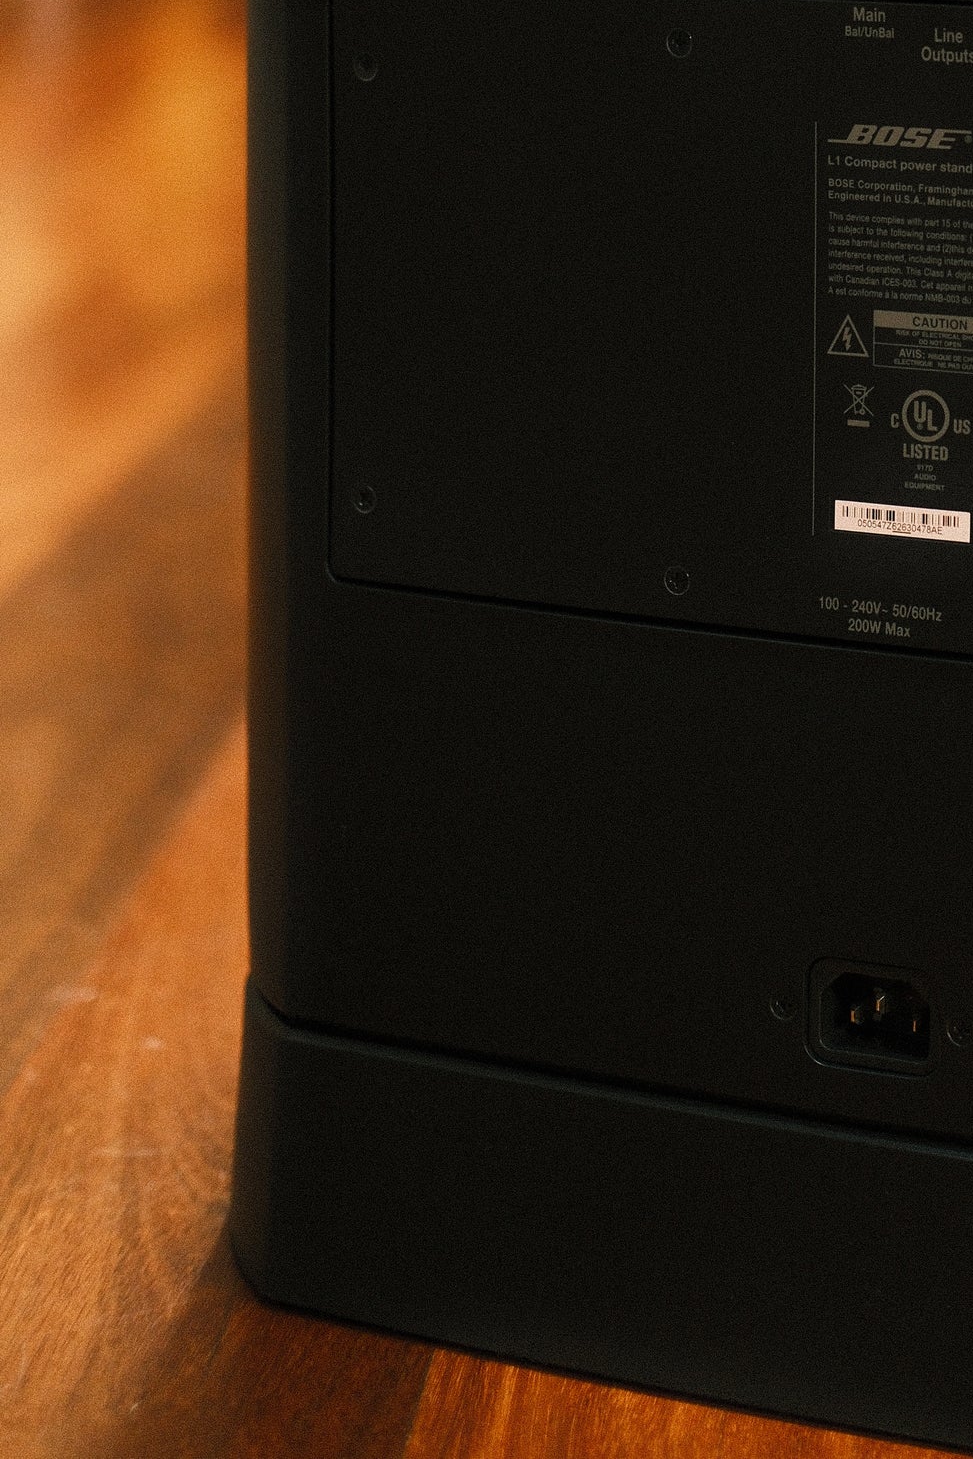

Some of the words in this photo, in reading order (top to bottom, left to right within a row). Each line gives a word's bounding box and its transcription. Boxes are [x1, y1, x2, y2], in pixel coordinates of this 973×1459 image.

[853, 7, 886, 22] Main
[845, 26, 894, 39] Bal/UnBal
[934, 28, 963, 43] Line
[827, 123, 972, 150] BOSE
[828, 155, 841, 165] L1
[845, 156, 897, 171] Compact
[900, 162, 936, 173] power
[940, 163, 973, 174] stand
[828, 178, 855, 188] BOSE
[857, 180, 916, 192] Corporation,
[828, 190, 880, 204] Engineered
[883, 194, 892, 202] in
[829, 211, 844, 221] This
[846, 214, 869, 222] device
[872, 216, 905, 225] complies
[924, 219, 939, 227] part
[942, 219, 951, 228] 15
[952, 220, 960, 228] of
[962, 221, 973, 229] the
[829, 224, 835, 232] is
[837, 225, 864, 235] subject
[866, 227, 874, 235] to
[876, 228, 888, 236] the
[891, 228, 924, 240] following
[828, 238, 850, 246] cause
[852, 239, 879, 248] harmful
[881, 240, 924, 251] interference
[926, 244, 941, 252] and
[829, 249, 871, 260] interference
[909, 257, 942, 266] including
[828, 262, 864, 272] undesired
[906, 266, 921, 276] This
[924, 268, 944, 277] Class
[829, 274, 843, 283] with
[846, 275, 879, 286] Canadian
[921, 280, 933, 289] Cet
[936, 282, 966, 292] appareil
[828, 286, 833, 294] A
[835, 287, 846, 295] est
[848, 288, 883, 299] conforme
[891, 291, 898, 299] la
[900, 292, 923, 301] norme
[925, 293, 960, 303] NMB-003
[962, 296, 971, 304] du
[912, 316, 968, 331] CAUTION
[896, 329, 910, 337] RISK
[922, 331, 961, 341] ELECTRICAL
[946, 340, 961, 348] OPEN
[899, 348, 925, 359] AVIS:
[928, 353, 951, 362] RISQUE
[894, 358, 933, 368] ELECTRIQUE
[953, 419, 971, 435] US
[903, 443, 949, 461] LISTED
[914, 472, 937, 481] AUDIO
[904, 482, 945, 491] EQUIPMENT
[819, 596, 840, 611] 100
[892, 604, 942, 622] 50/60Hz
[848, 618, 881, 634] 200W
[885, 622, 911, 637] Max
